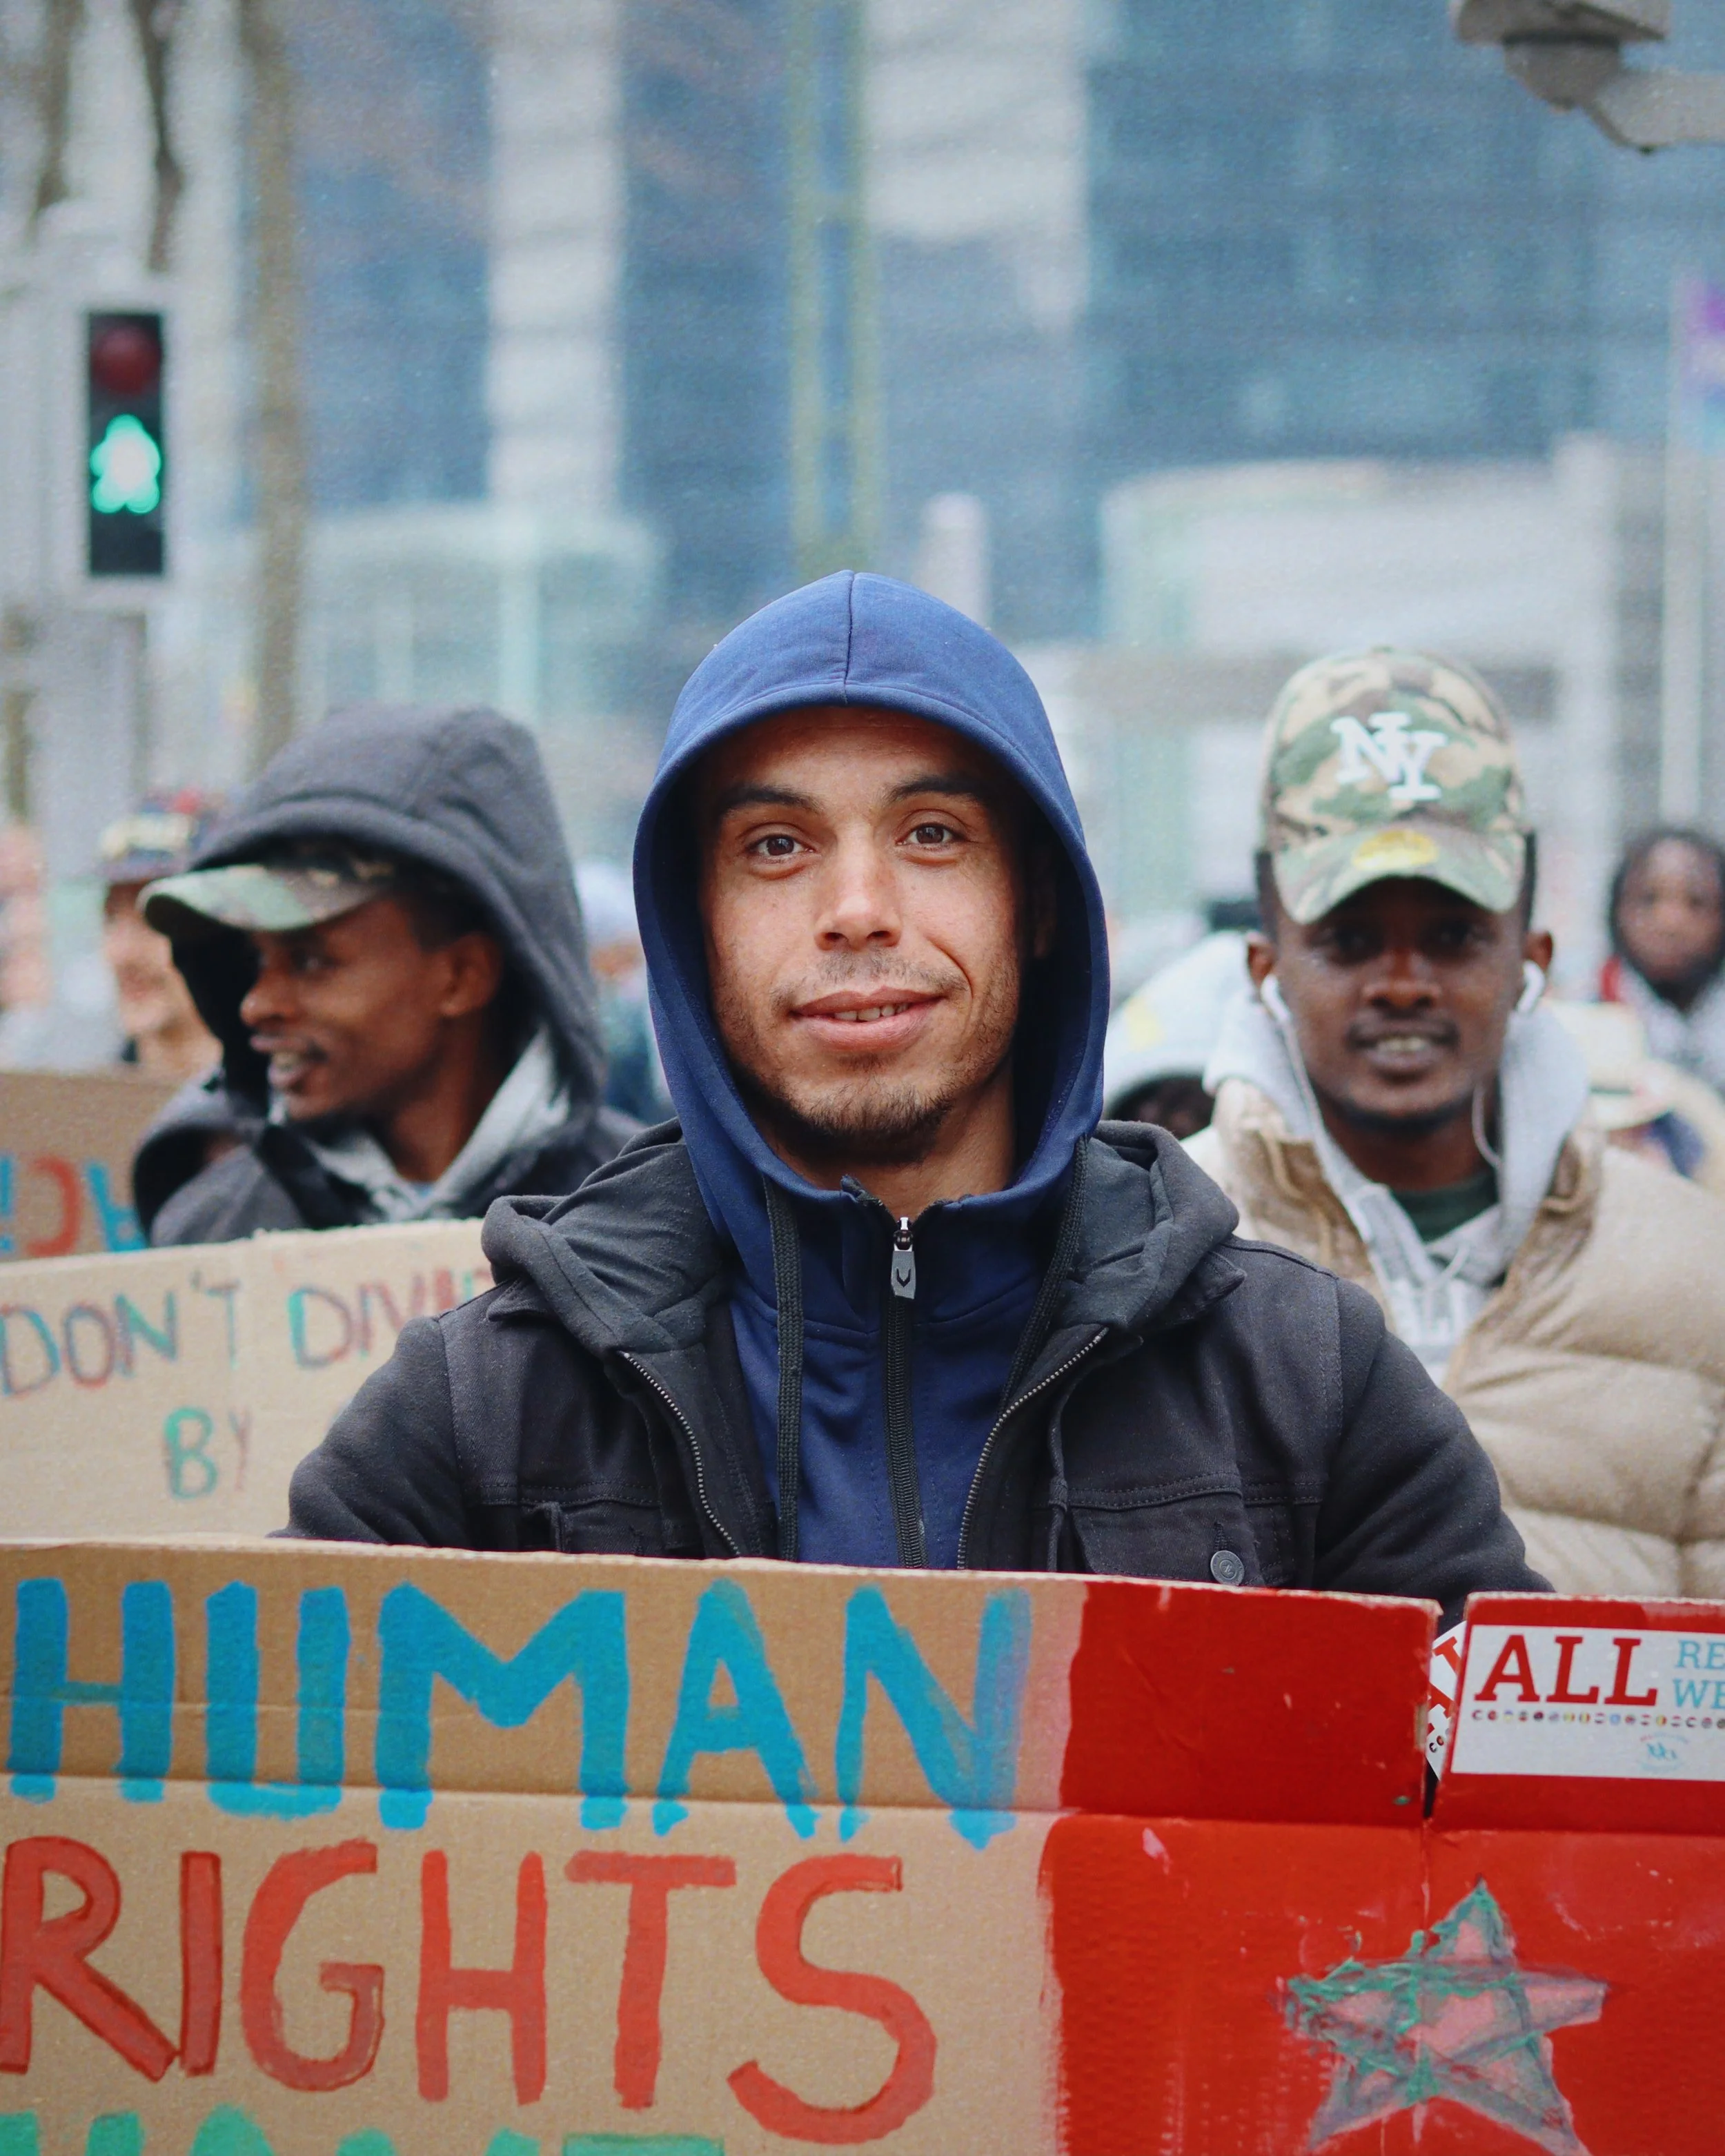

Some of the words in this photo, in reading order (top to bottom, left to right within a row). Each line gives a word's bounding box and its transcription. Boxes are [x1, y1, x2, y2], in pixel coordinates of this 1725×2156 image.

[1330, 712, 1447, 800] NY
[0, 1270, 241, 1398] DON'T
[163, 1406, 252, 1500] BY
[6, 1577, 1032, 1850] HUMAN
[1474, 1634, 1657, 1706] ALL
[0, 1835, 938, 2144] RIGHTS
